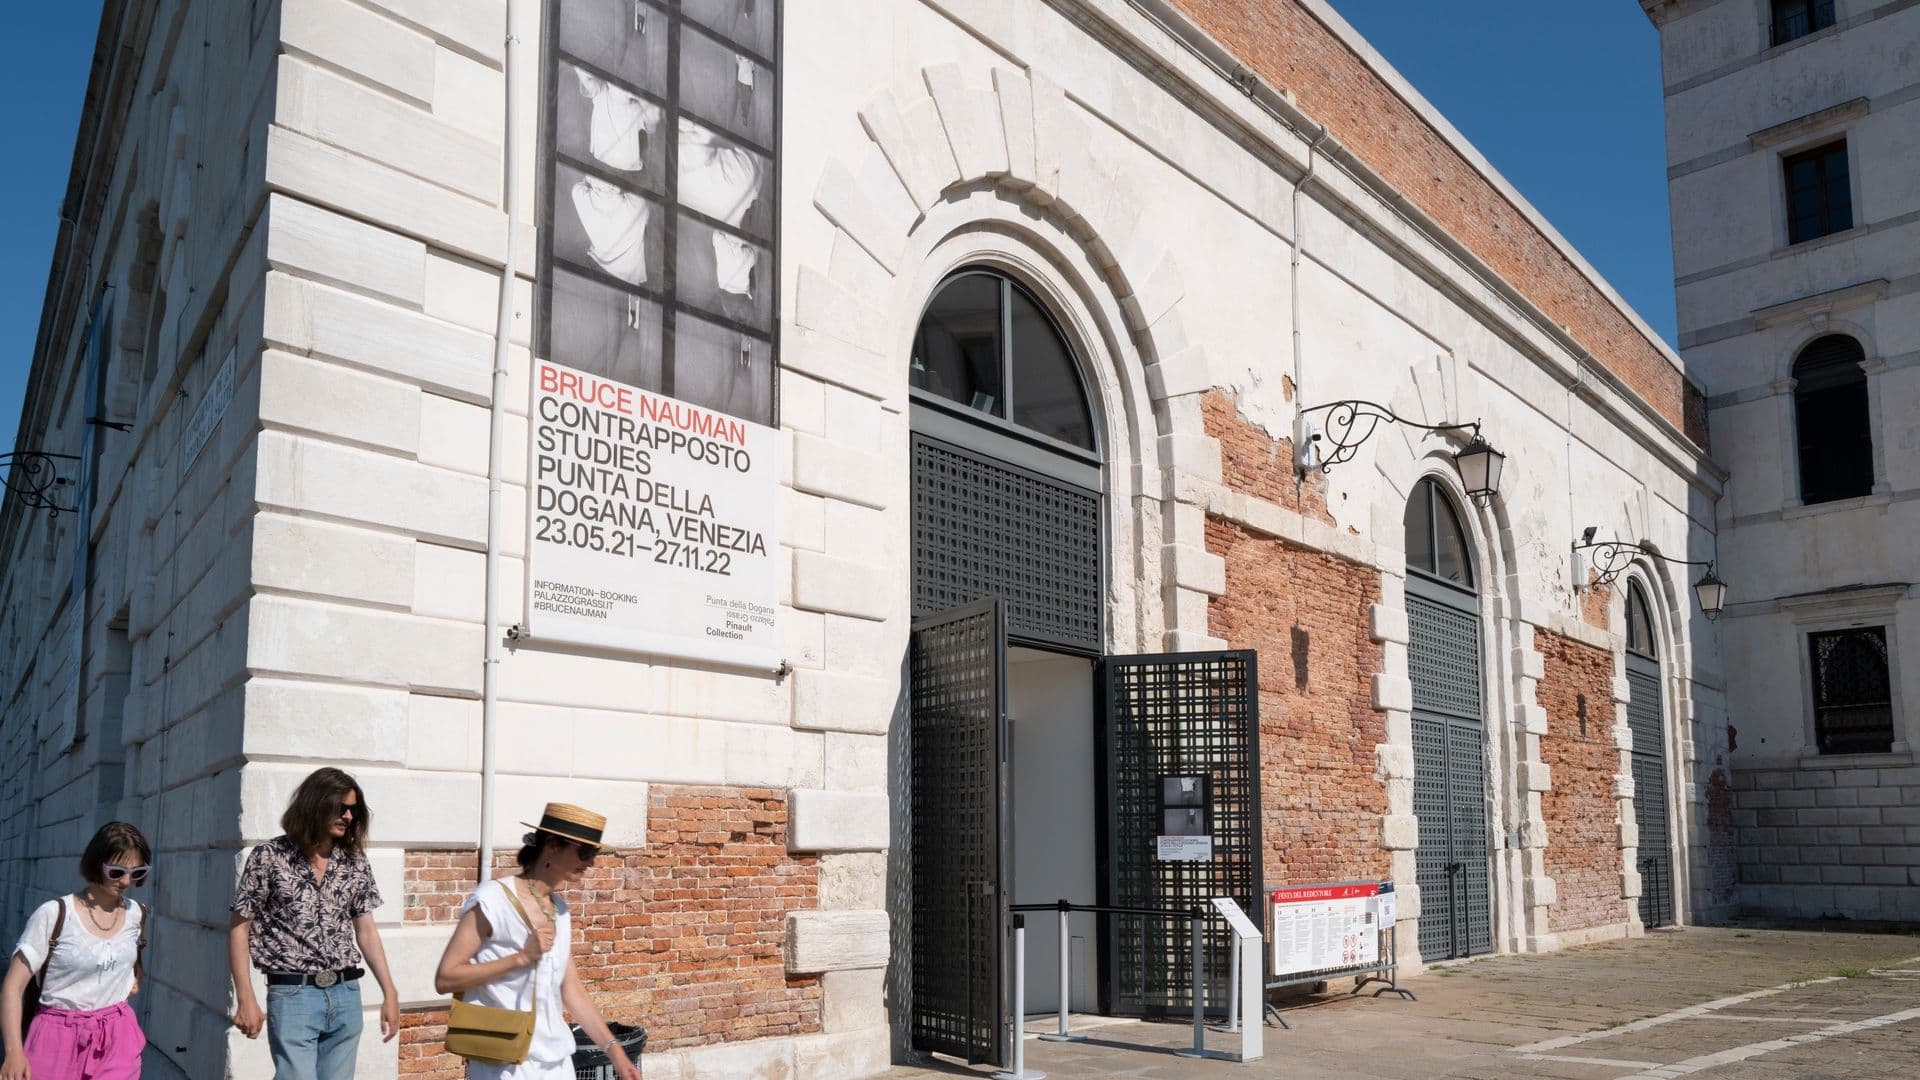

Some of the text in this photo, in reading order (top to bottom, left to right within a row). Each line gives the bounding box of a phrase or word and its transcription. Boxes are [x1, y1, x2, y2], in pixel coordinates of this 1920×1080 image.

[540, 365, 745, 446] BRUCE NAUMAN
[537, 425, 651, 475] STUDIES
[539, 396, 751, 473] CONTRAPPOSTO
[537, 454, 715, 518] PUNTA DELLA
[537, 485, 767, 557] DOGANA, VENEZIA
[534, 590, 614, 610] PALAZZOGRASSI.IT
[534, 601, 607, 619] #BRUCENAUMAN
[706, 594, 775, 615] Punta della Dogana
[706, 626, 744, 640] Collection
[726, 620, 752, 632] Pinault
